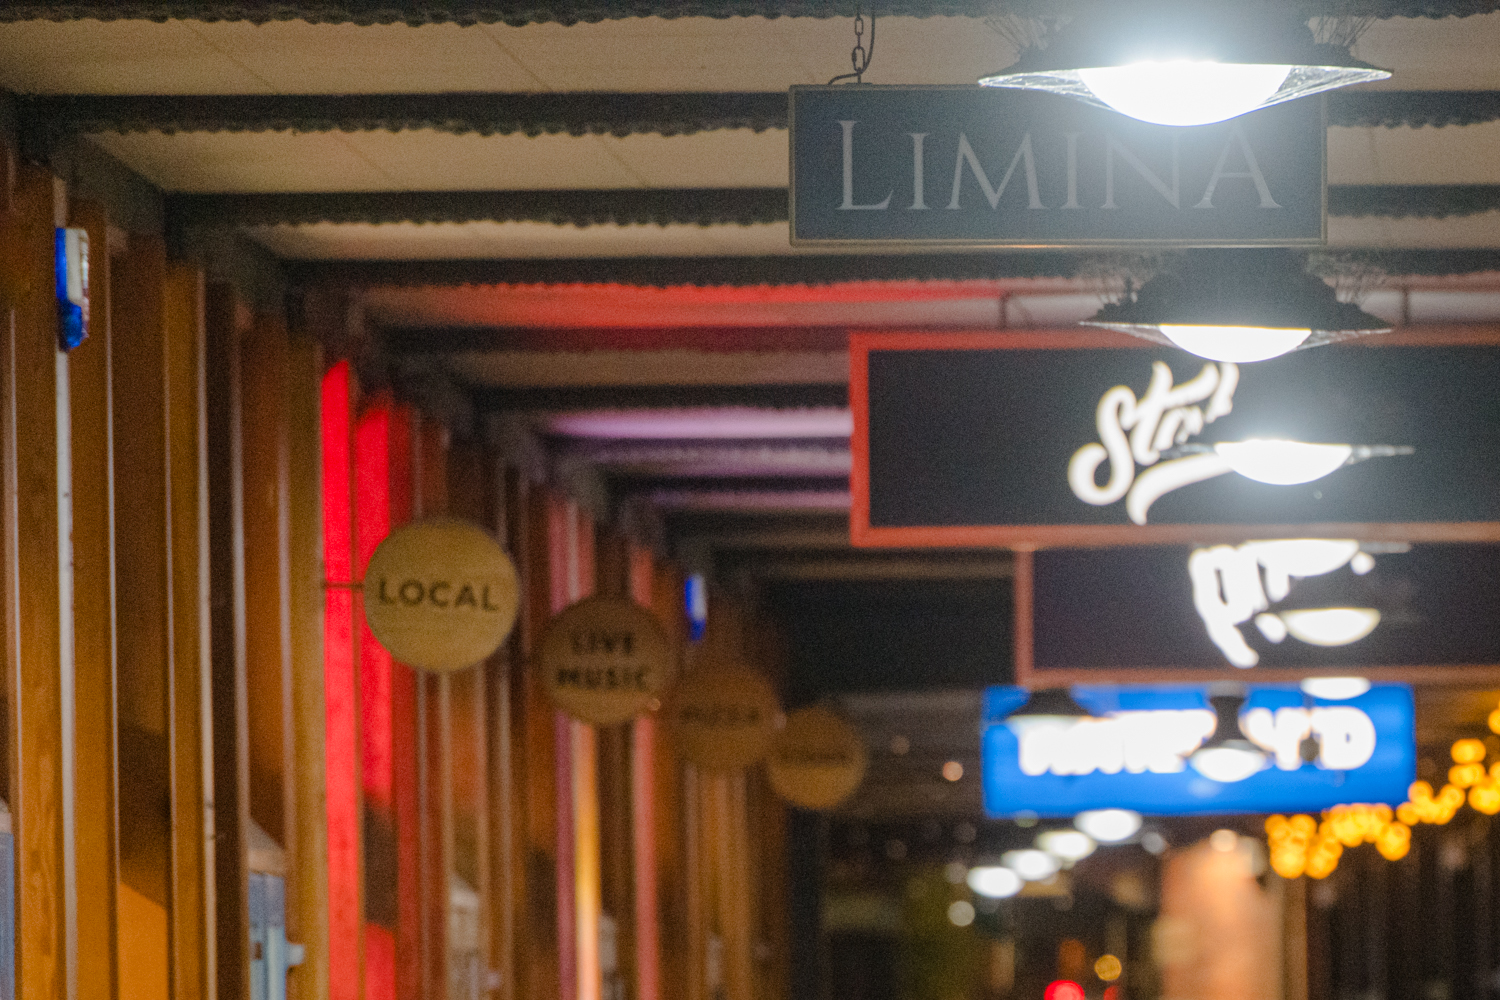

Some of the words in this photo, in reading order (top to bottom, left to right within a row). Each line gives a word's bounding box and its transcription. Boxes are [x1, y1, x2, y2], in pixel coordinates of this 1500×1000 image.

[835, 119, 1282, 211] LIMINA
[377, 576, 500, 612] LOCAL
[572, 631, 635, 654] LIVE
[556, 666, 648, 690] MUSIC
